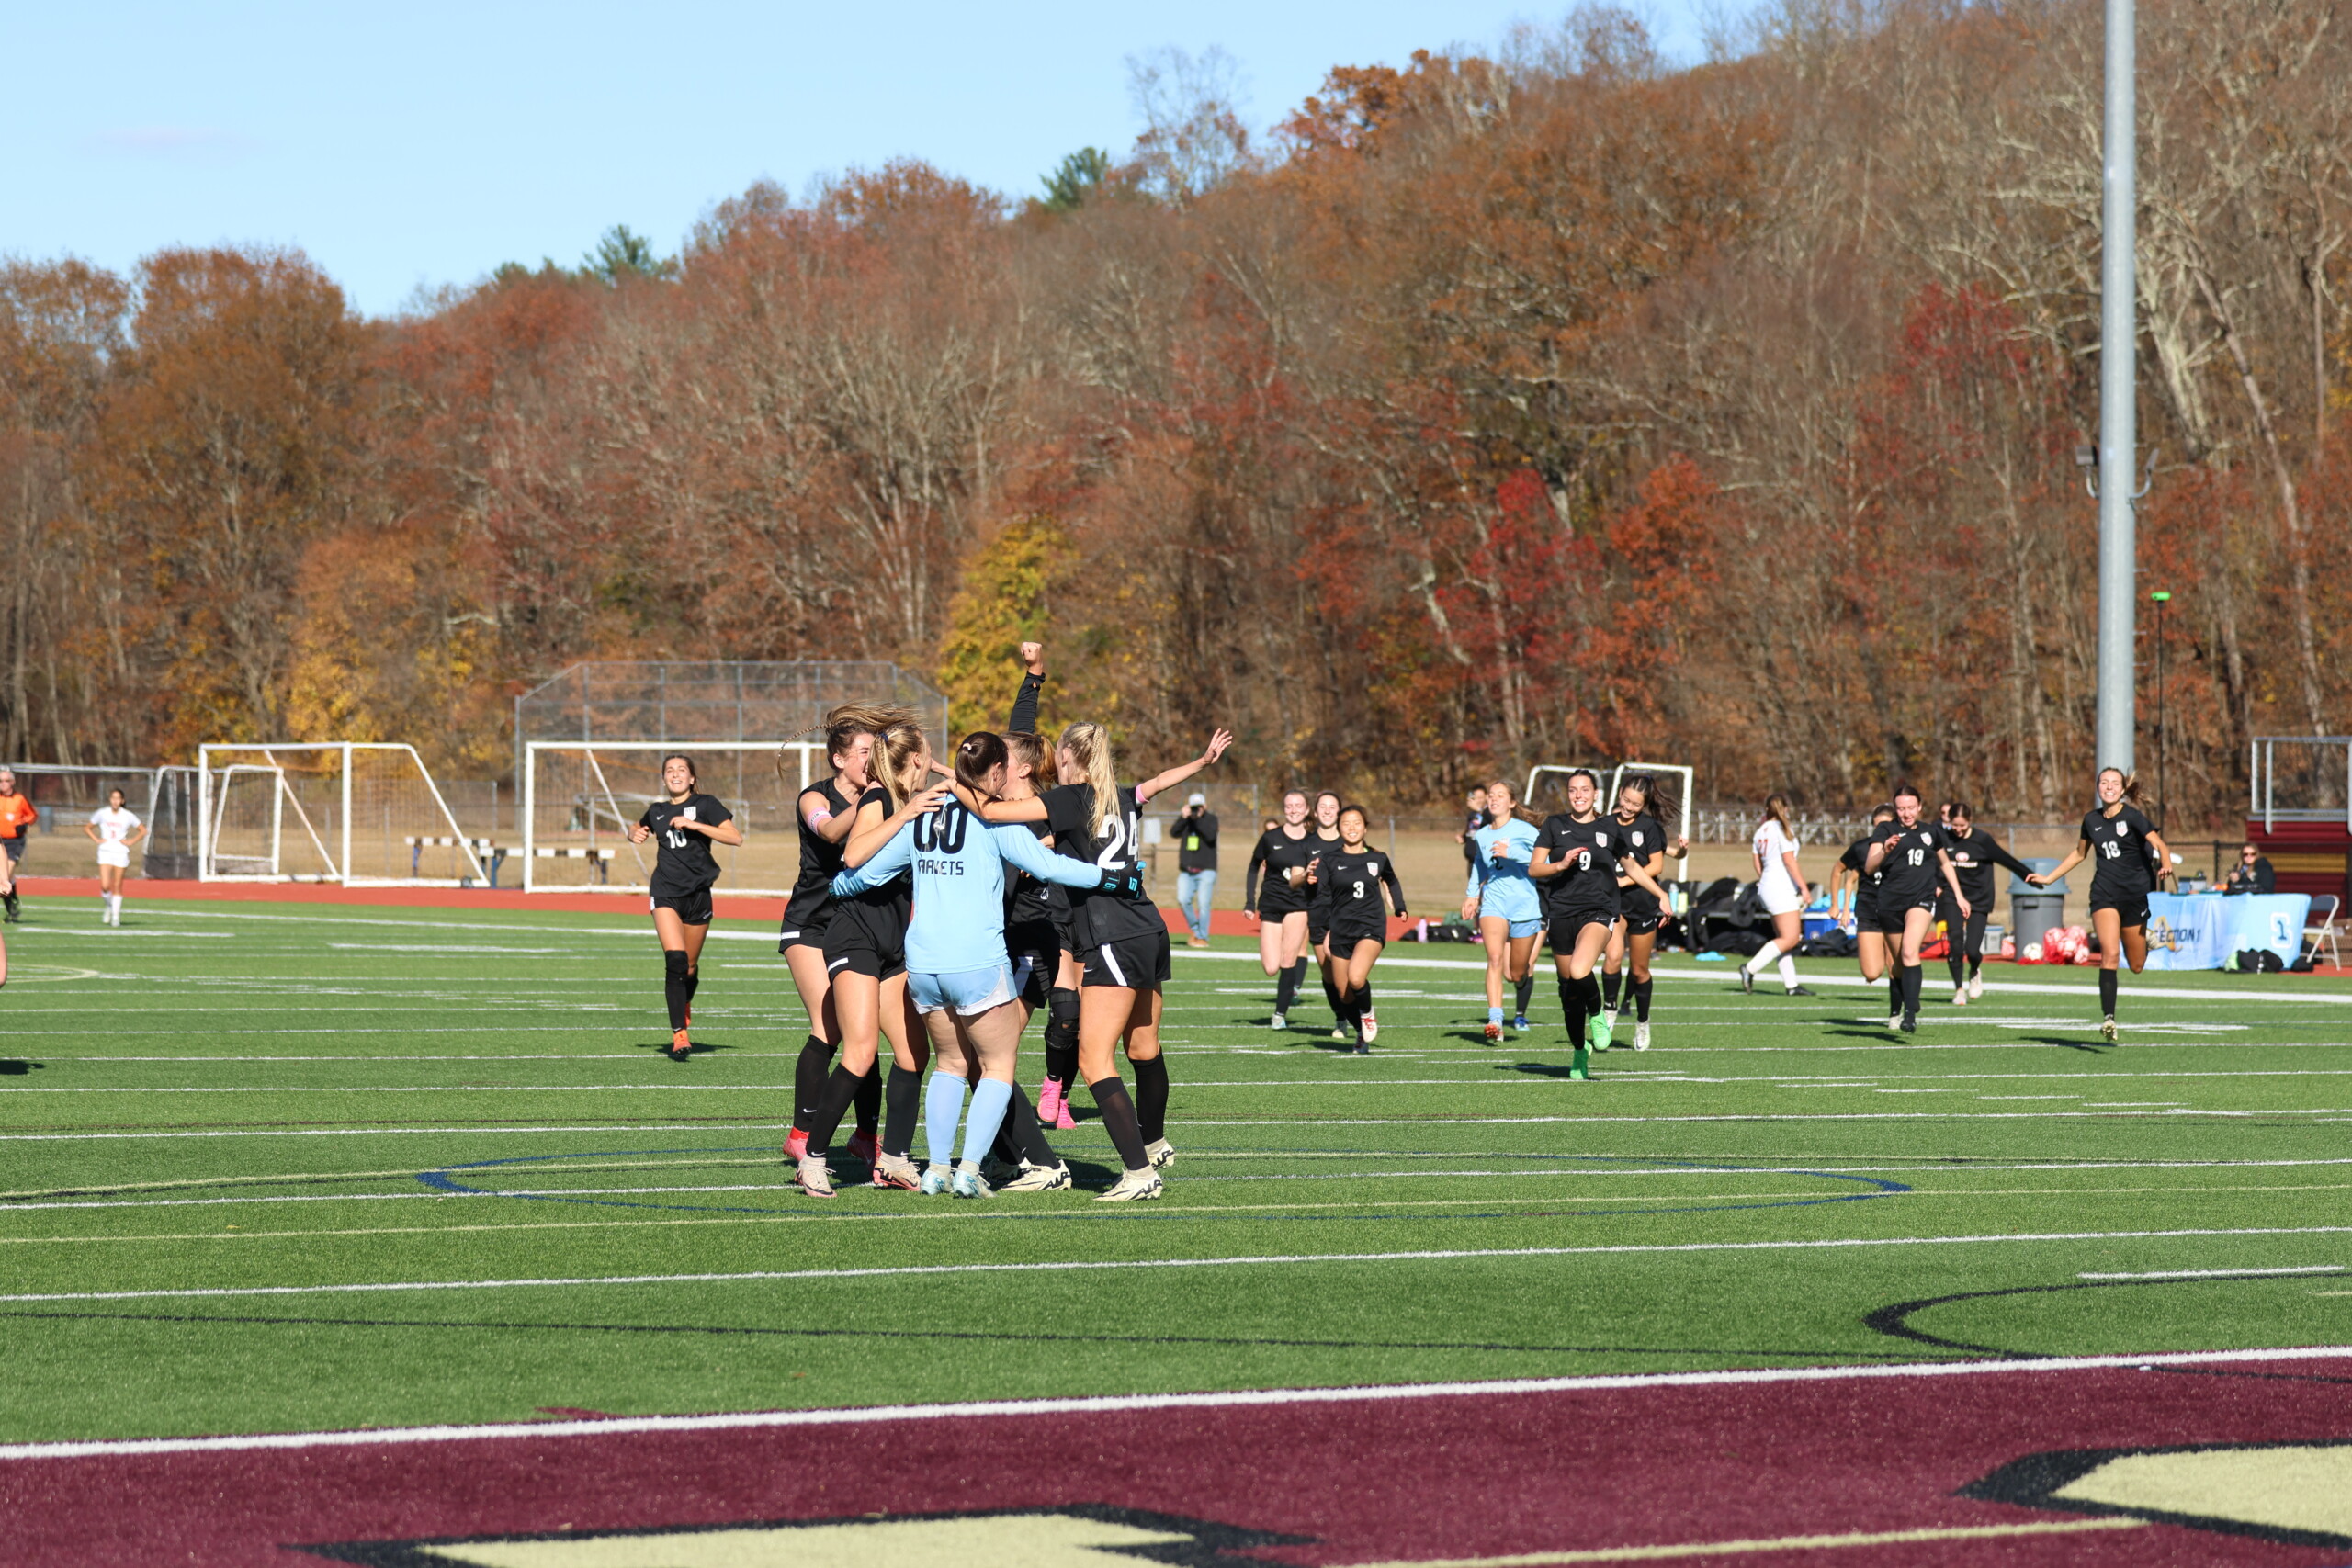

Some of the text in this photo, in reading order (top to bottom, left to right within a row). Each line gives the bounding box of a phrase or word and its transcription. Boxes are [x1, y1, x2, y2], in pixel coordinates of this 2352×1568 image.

[913, 801, 969, 854] 00
[666, 829, 687, 849] 10
[1097, 812, 1139, 870] 24
[1907, 848, 1925, 866] 19
[2101, 840, 2121, 860] 18
[1579, 851, 1591, 871] 9
[1353, 881, 1364, 898] 3
